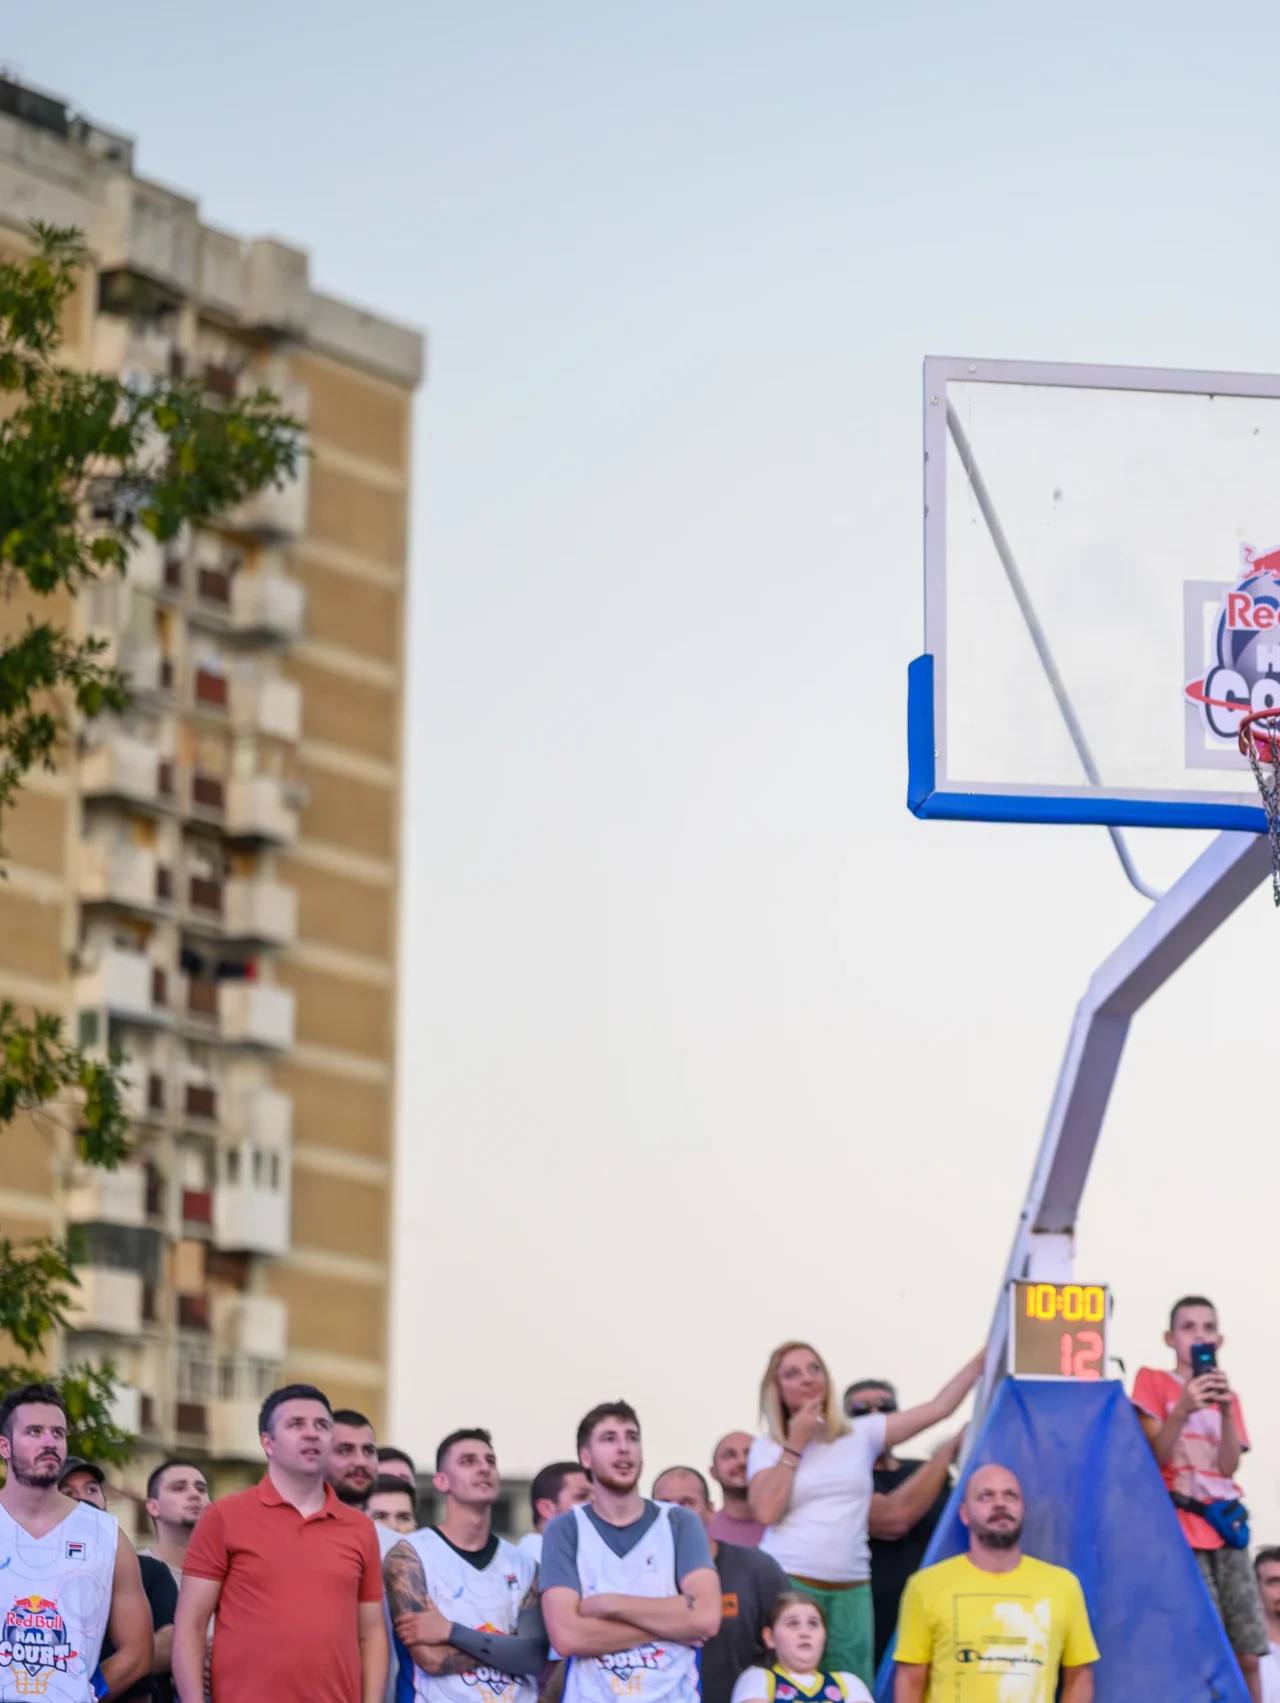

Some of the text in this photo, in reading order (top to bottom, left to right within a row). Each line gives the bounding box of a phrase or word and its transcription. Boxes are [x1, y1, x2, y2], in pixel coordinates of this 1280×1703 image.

[1026, 1284, 1104, 1322] 10:00
[1060, 1330, 1104, 1380] 12
[7, 1612, 62, 1630] Red Bull
[0, 1640, 70, 1672] COURT
[956, 1648, 1044, 1667] Champion
